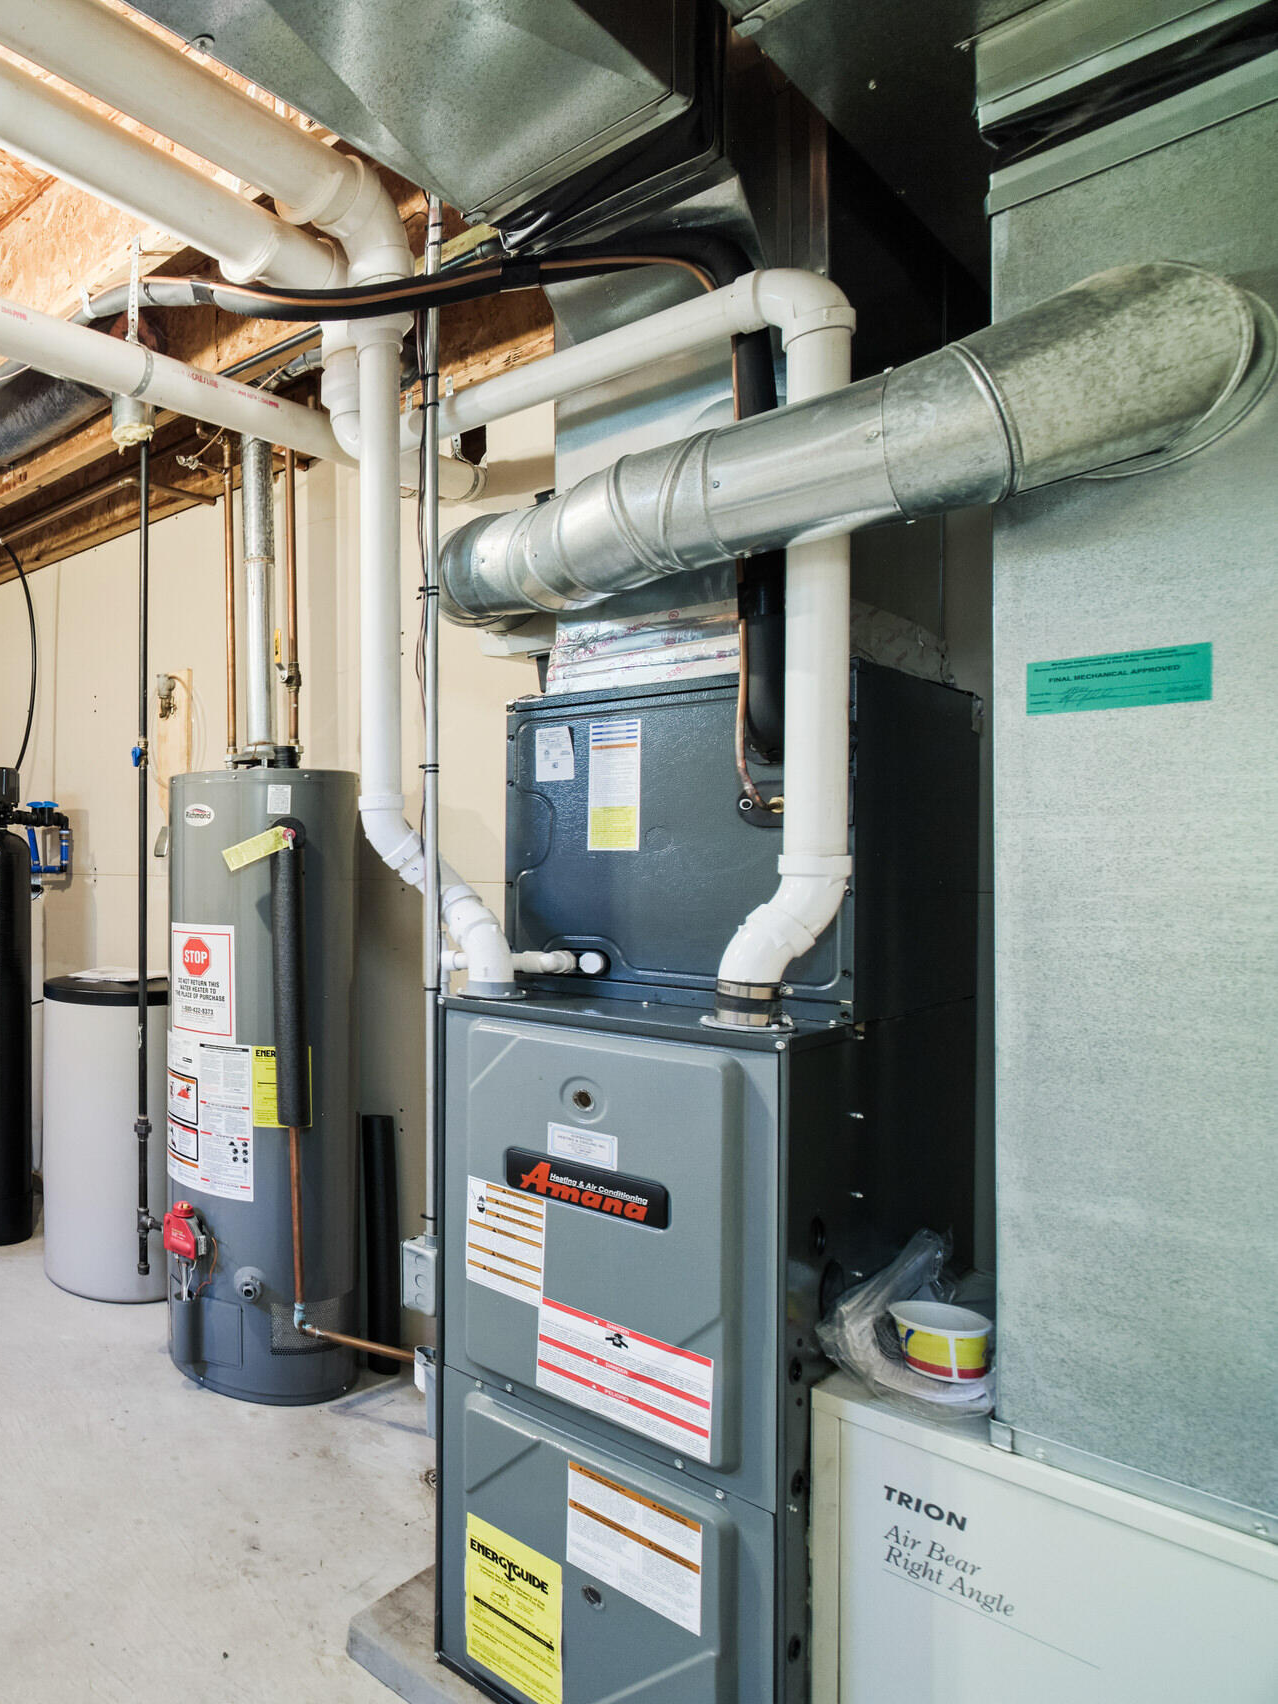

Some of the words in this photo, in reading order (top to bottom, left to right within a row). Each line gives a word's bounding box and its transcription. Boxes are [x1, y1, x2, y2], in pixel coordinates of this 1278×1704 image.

[1048, 675, 1072, 683] FINAL
[1074, 669, 1129, 681] MECHANICAL
[1130, 664, 1181, 676] APPROVED
[186, 811, 211, 820] Richmond
[184, 950, 208, 964] STOP
[190, 979, 207, 987] RETURN
[192, 985, 209, 994] HEATER
[209, 987, 217, 995] TO
[199, 994, 226, 1002] PURCHASE
[520, 1161, 649, 1222] Amana
[549, 1173, 577, 1188] Heating
[578, 1179, 585, 1189] &
[586, 1181, 598, 1192] Air
[598, 1185, 649, 1206] Conditioning
[606, 1323, 630, 1336] DANGER
[883, 1484, 967, 1531] TRION
[884, 1525, 922, 1550] Air
[926, 1540, 982, 1576] Bear
[884, 1544, 944, 1585] Right
[948, 1576, 1015, 1617] Angle
